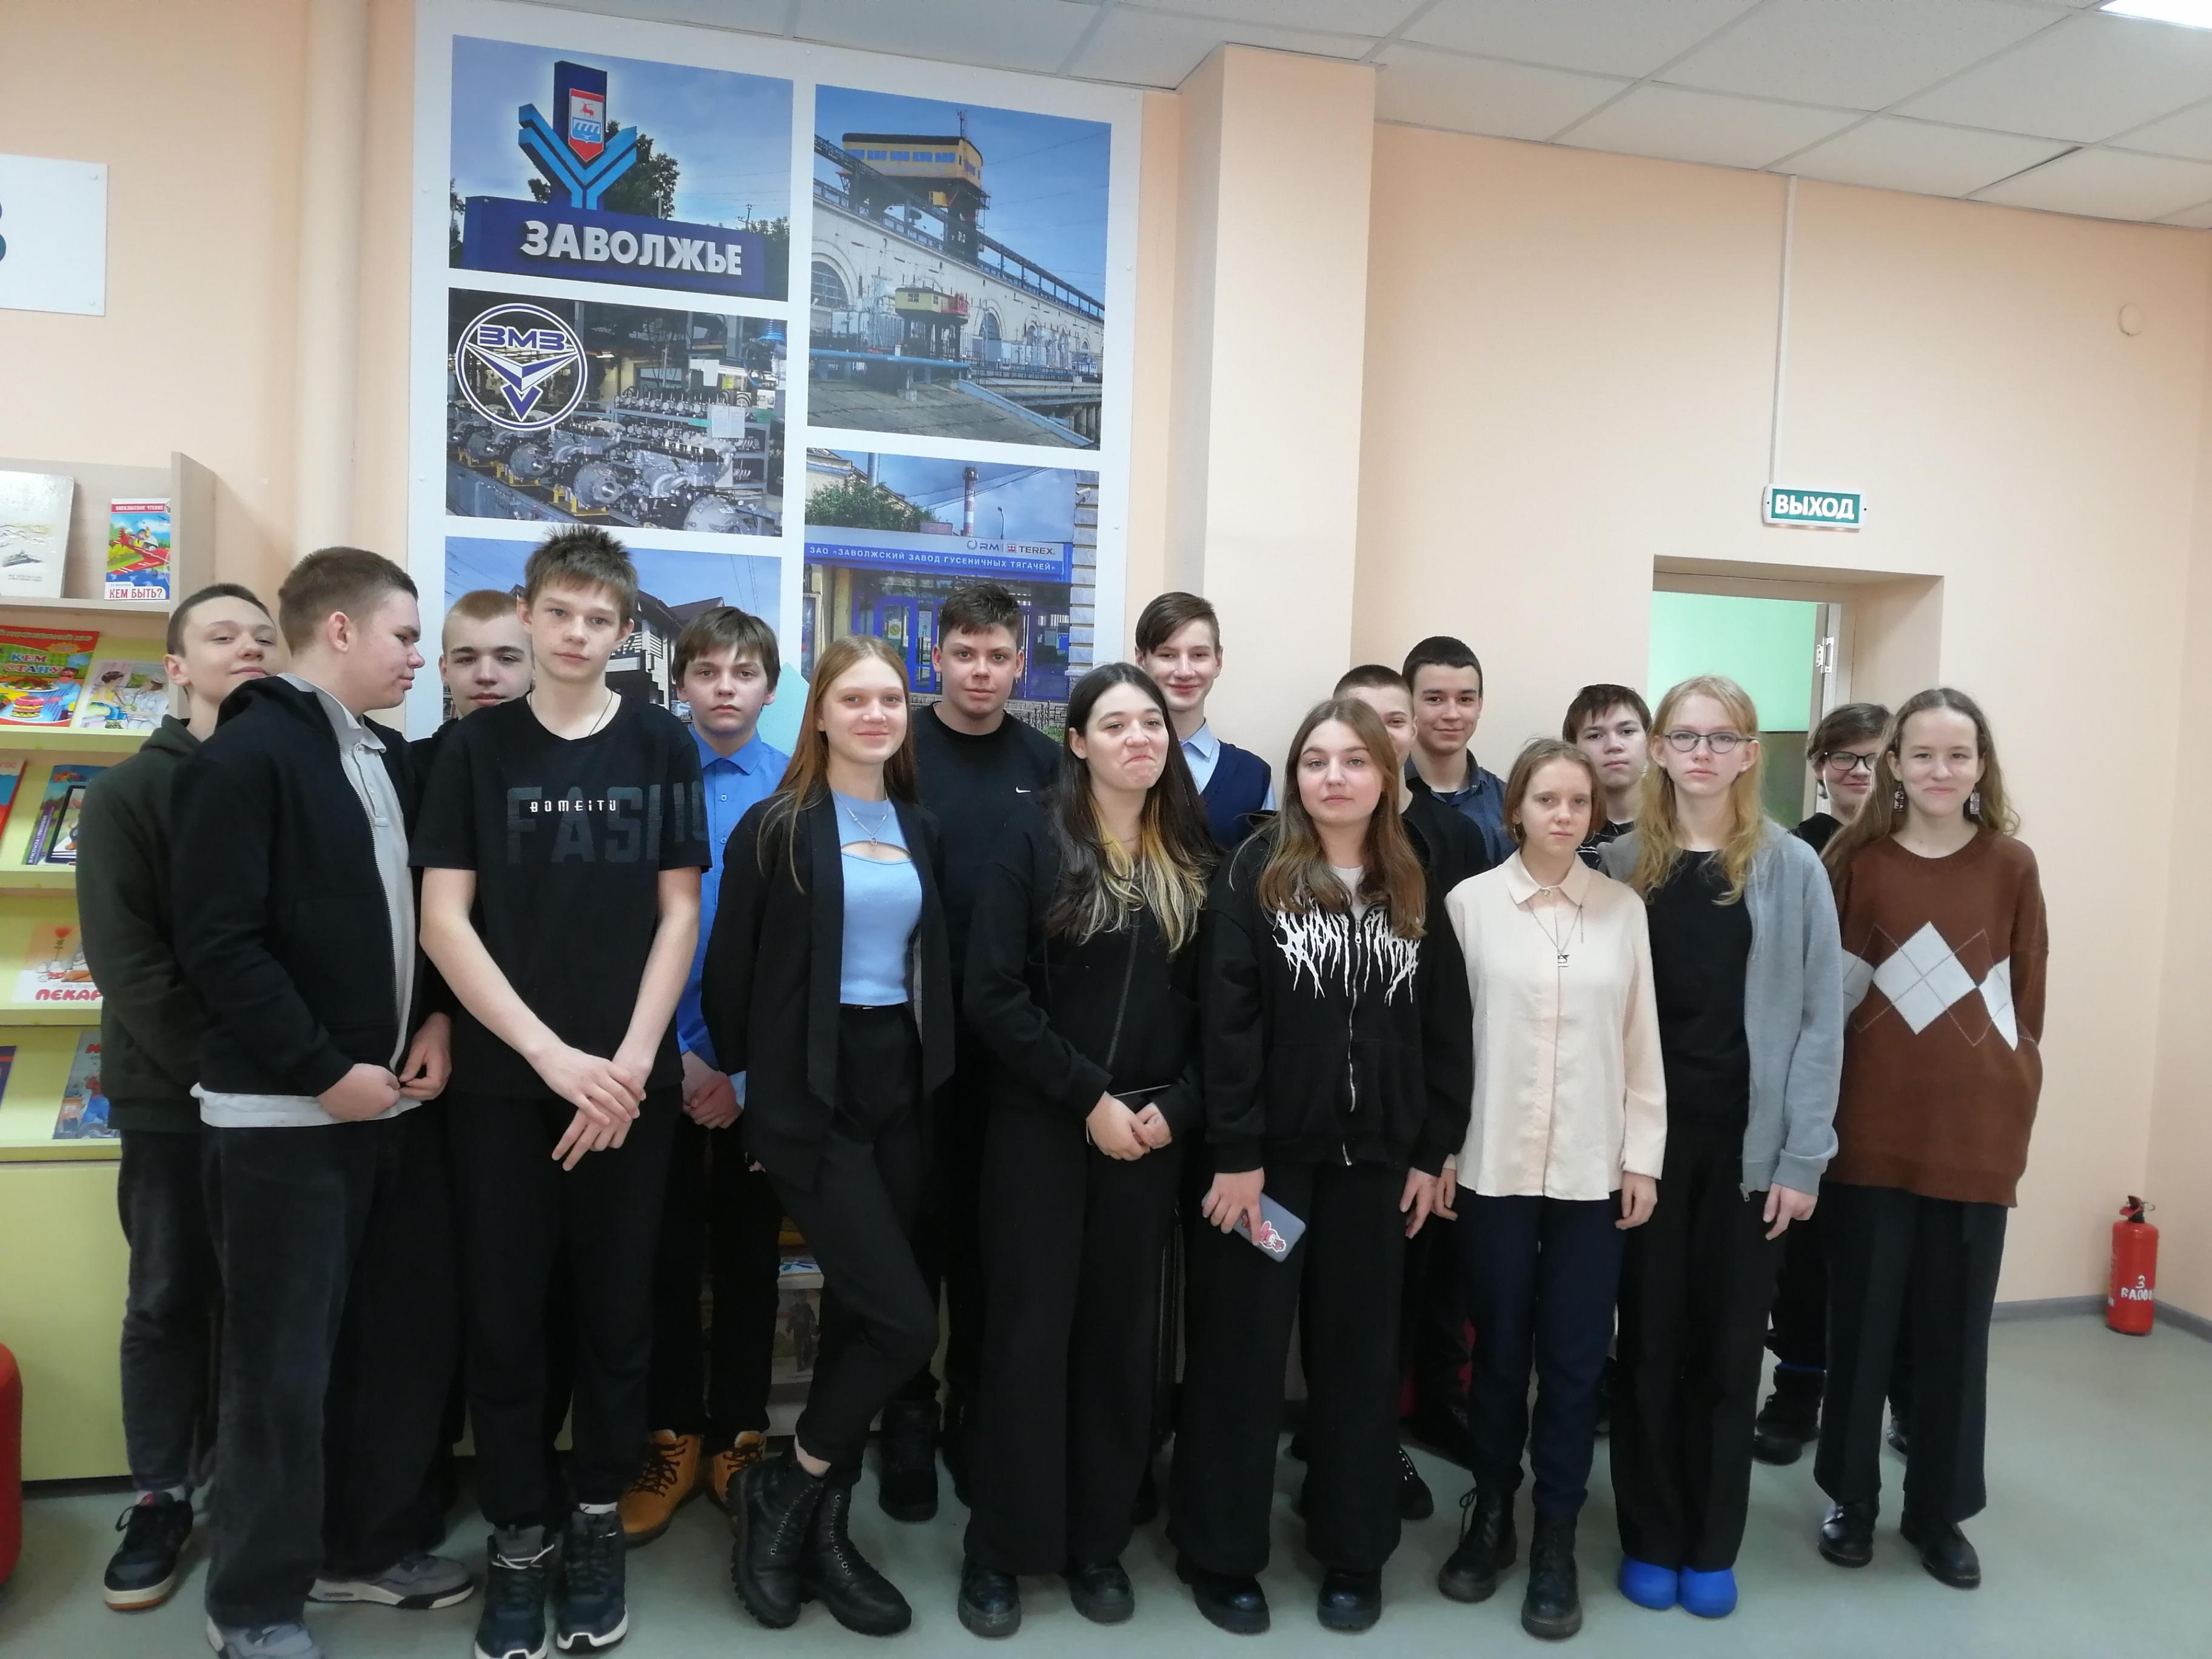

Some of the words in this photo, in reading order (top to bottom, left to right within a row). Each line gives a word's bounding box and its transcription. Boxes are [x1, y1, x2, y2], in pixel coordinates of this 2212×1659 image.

[520, 220, 742, 276] ЗАВОЛЖЬЕ
[1774, 494, 1855, 520] ВЫХОД
[1019, 545, 1054, 555] TEREX
[833, 548, 905, 560] «ЗАВОЛЖСКИЙ
[908, 553, 940, 563] ЗАВОД
[944, 556, 1007, 568] ГУСЕНИЧНЫХ
[1011, 561, 1055, 571] ТЯГАЧЕЙ»
[109, 589, 128, 598] КЕМ
[131, 588, 163, 598] БЫТЬ?
[10, 653, 47, 663] КЕМ
[4, 663, 64, 674] СТАНУ
[529, 800, 617, 813] BOMEITU
